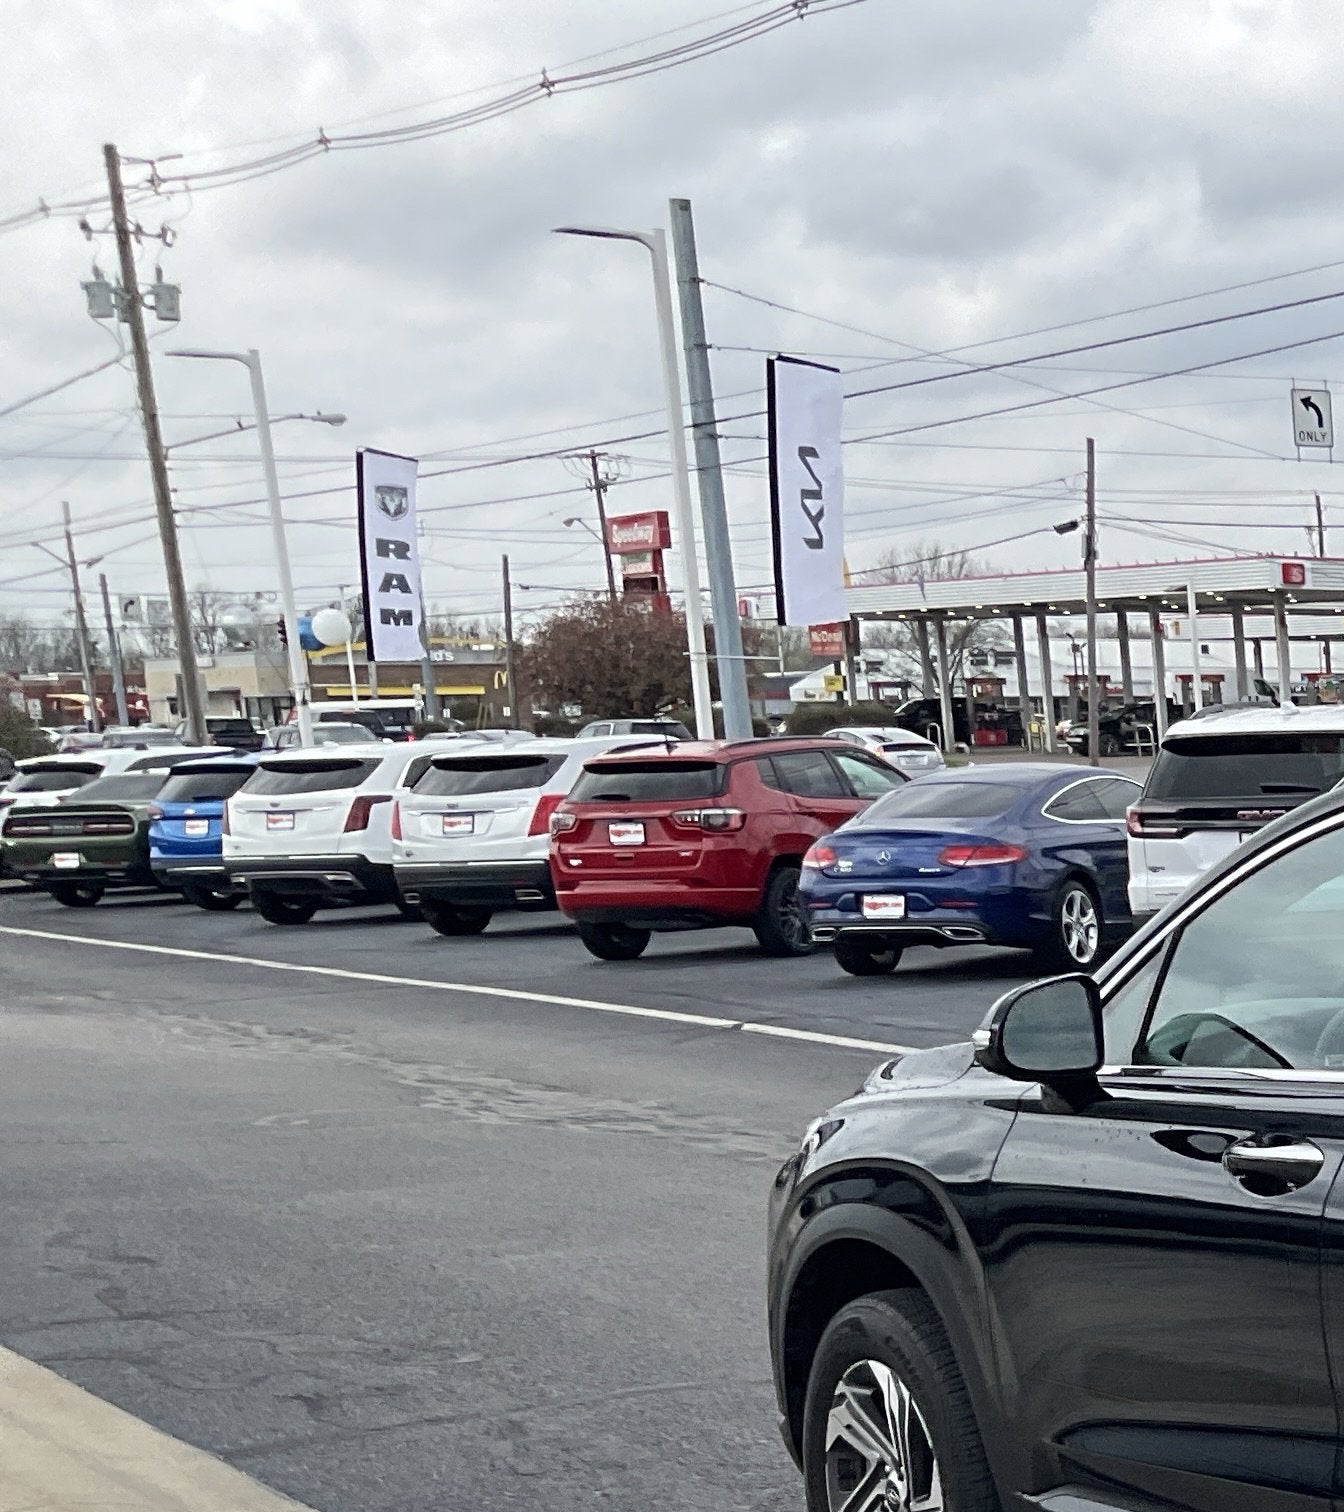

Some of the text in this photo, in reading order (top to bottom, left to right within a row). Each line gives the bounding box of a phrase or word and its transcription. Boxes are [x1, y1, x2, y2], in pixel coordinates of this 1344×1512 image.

[1298, 430, 1328, 442] ONLY
[798, 446, 824, 549] KIA
[612, 523, 654, 548] Speedway
[375, 537, 413, 626] RAM
